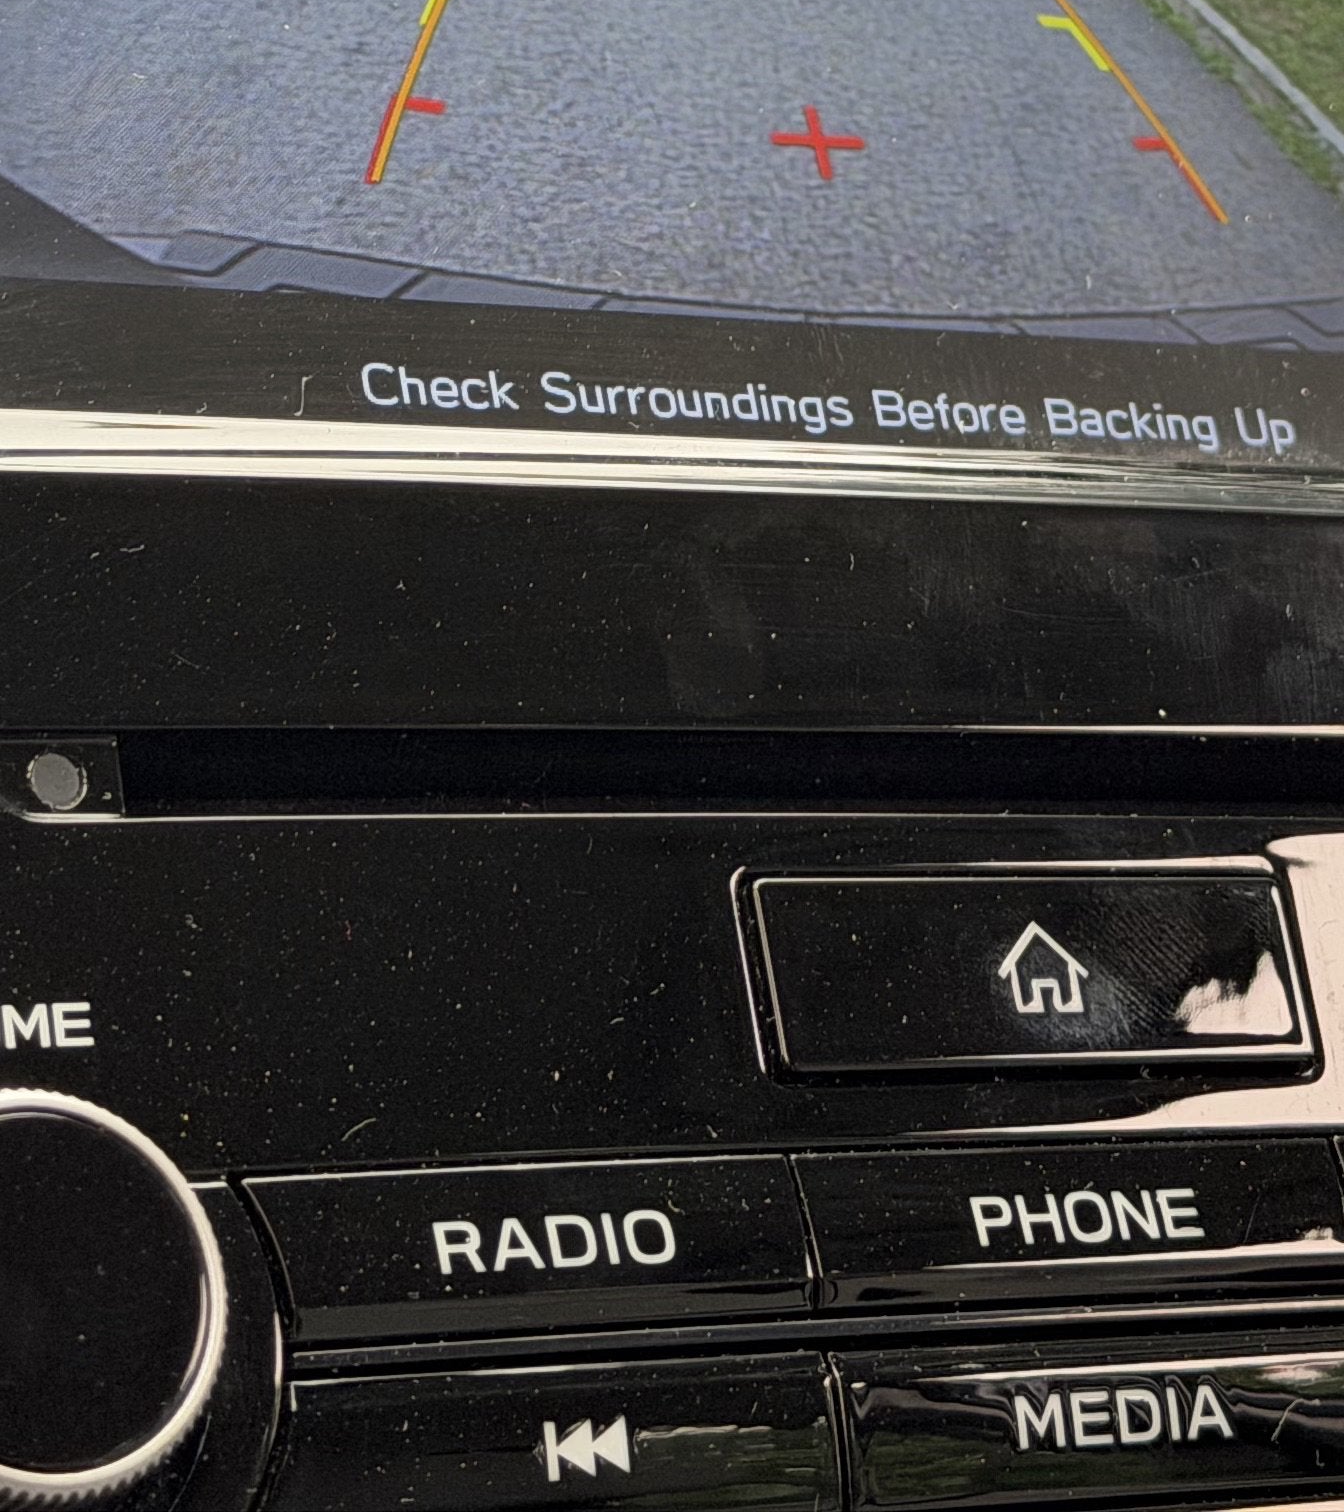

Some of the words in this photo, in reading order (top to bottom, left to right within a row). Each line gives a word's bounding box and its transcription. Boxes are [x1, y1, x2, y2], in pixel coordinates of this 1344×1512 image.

[361, 362, 519, 410] Check
[541, 370, 854, 434] Surroundings
[872, 388, 1027, 437] Before
[1047, 398, 1218, 455] Backing
[1234, 406, 1296, 456] Up
[431, 1208, 677, 1276] RADIO
[968, 1187, 1205, 1248] PHONE
[1012, 1383, 1235, 1451] MEDIA
